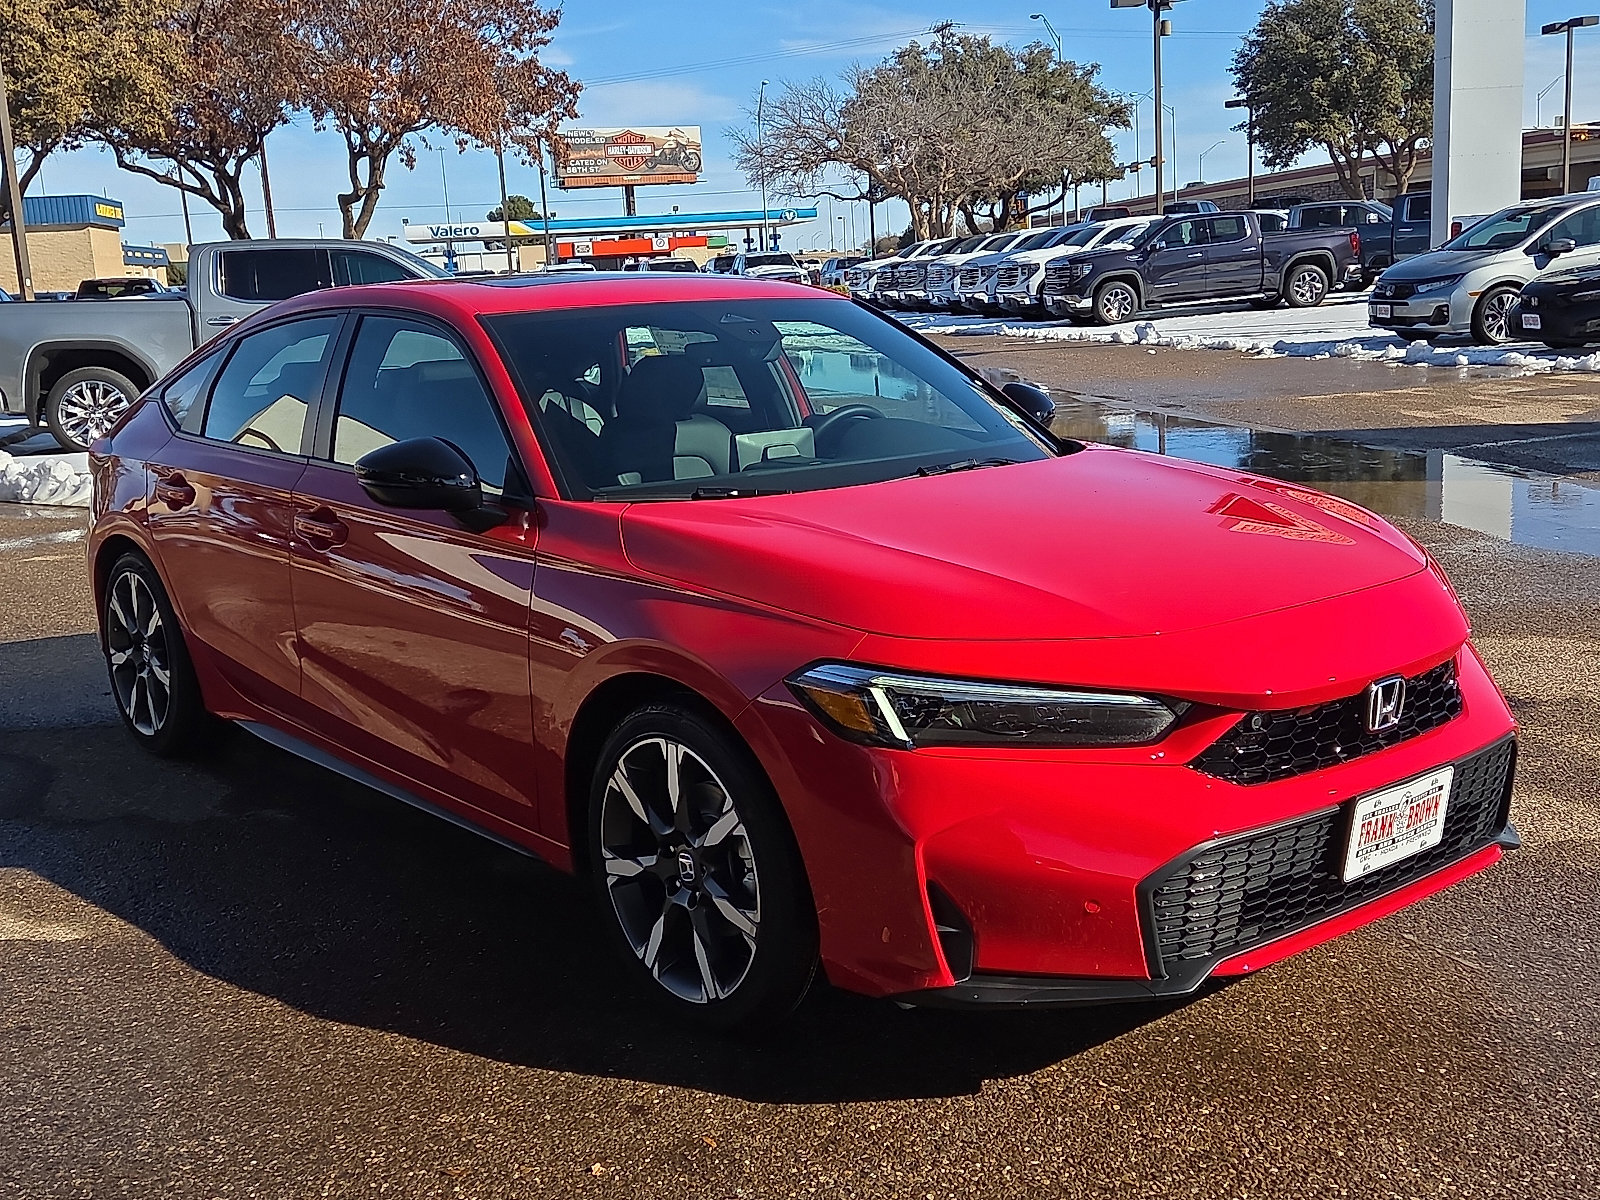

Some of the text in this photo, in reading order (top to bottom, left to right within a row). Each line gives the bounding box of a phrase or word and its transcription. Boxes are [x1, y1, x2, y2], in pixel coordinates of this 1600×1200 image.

[617, 134, 641, 144] MOTOR
[607, 145, 652, 155] HARLEY-DAVIDSON
[596, 158, 608, 166] ON
[619, 156, 643, 167] CYCLES
[429, 225, 480, 237] Valero
[1358, 793, 1442, 848] FRANK BROWN
[1357, 847, 1376, 858] AUTO
